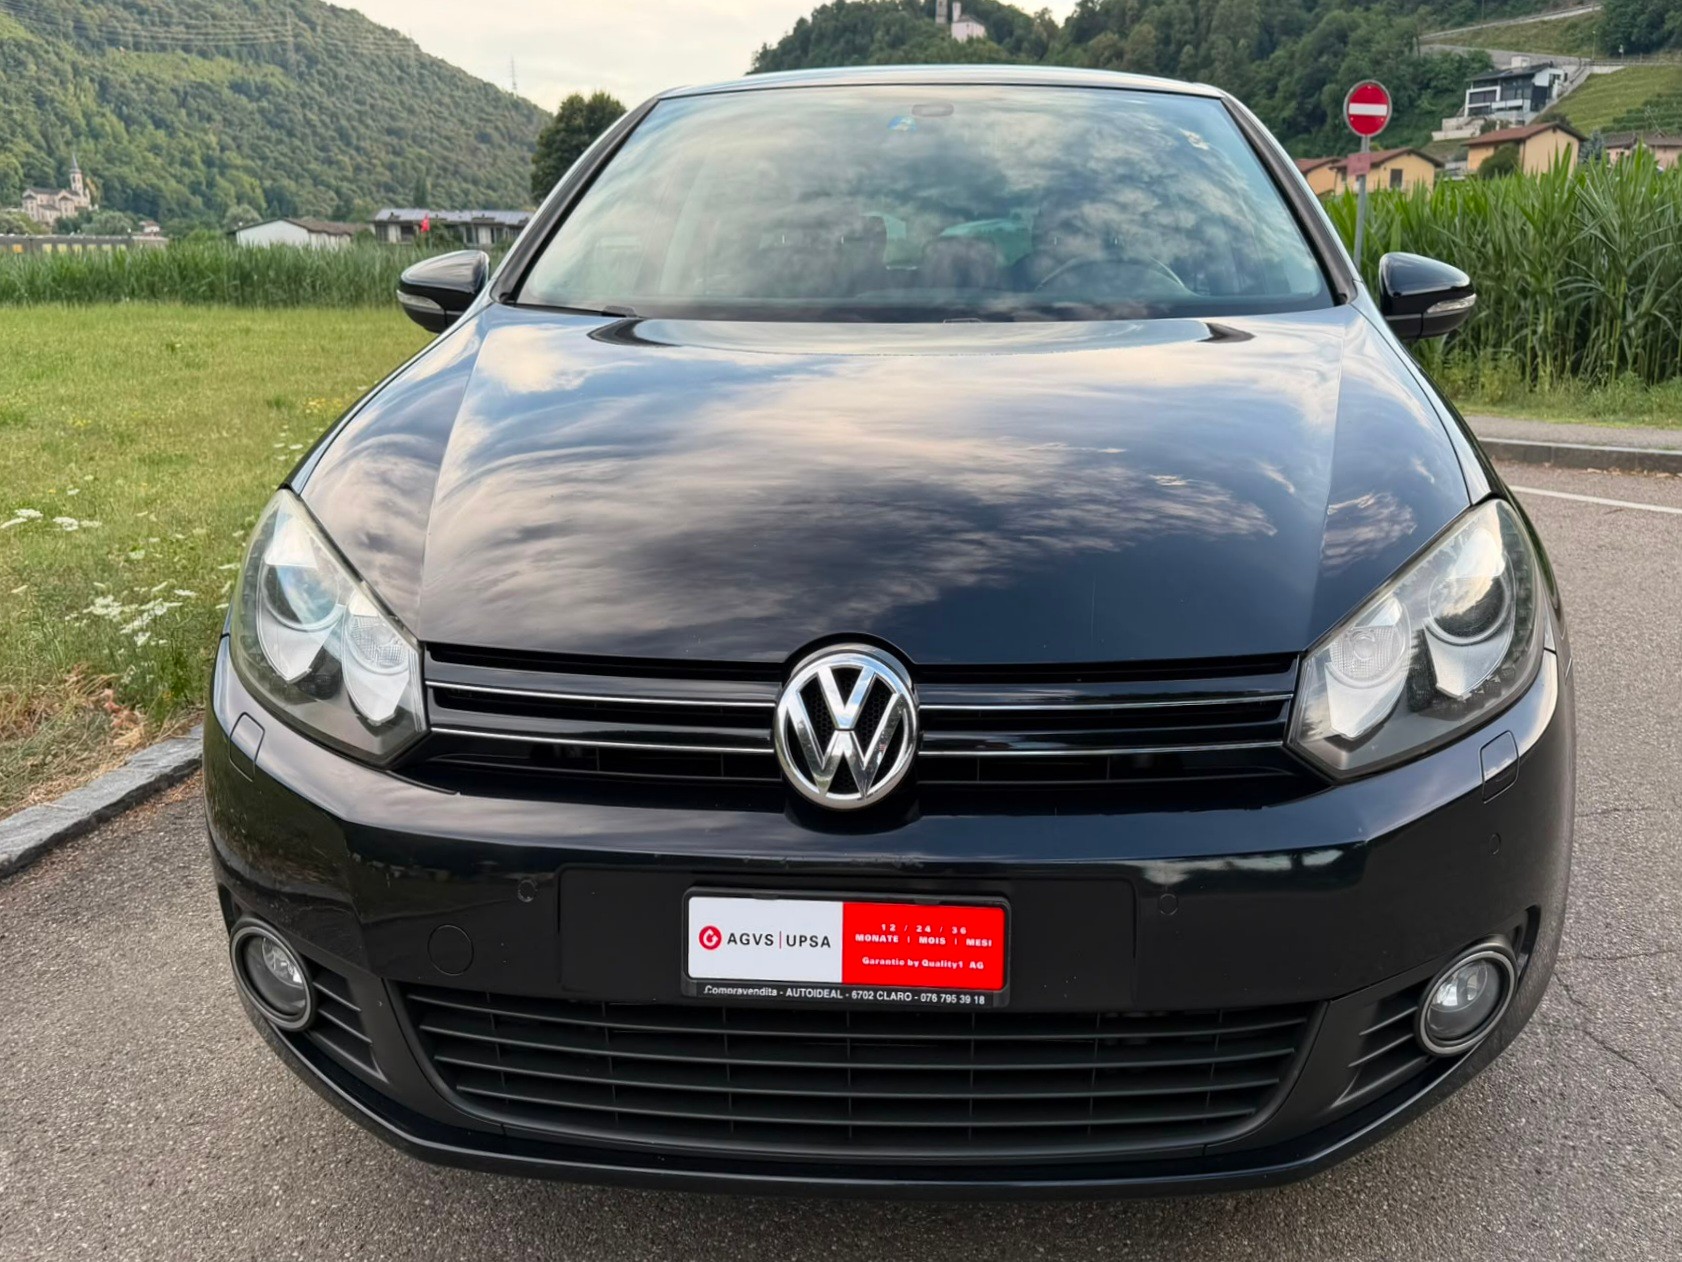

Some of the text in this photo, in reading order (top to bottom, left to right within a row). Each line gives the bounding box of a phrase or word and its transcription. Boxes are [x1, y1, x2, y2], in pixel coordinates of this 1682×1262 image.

[916, 925, 931, 933] 24
[952, 927, 967, 935] 36
[727, 932, 831, 948] AGVS UPSA
[855, 933, 899, 943] MONATE
[919, 935, 946, 945] MOIS
[966, 938, 993, 947] MESI
[862, 957, 984, 970] Garantie by Quality1 AG
[785, 988, 843, 999] AUTOIDEAL
[852, 990, 874, 1000] 6702
[877, 991, 912, 1001] CLARO
[920, 993, 938, 1003] 076
[940, 994, 957, 1004] 795
[959, 995, 971, 1004] 39
[974, 995, 985, 1005] 18
